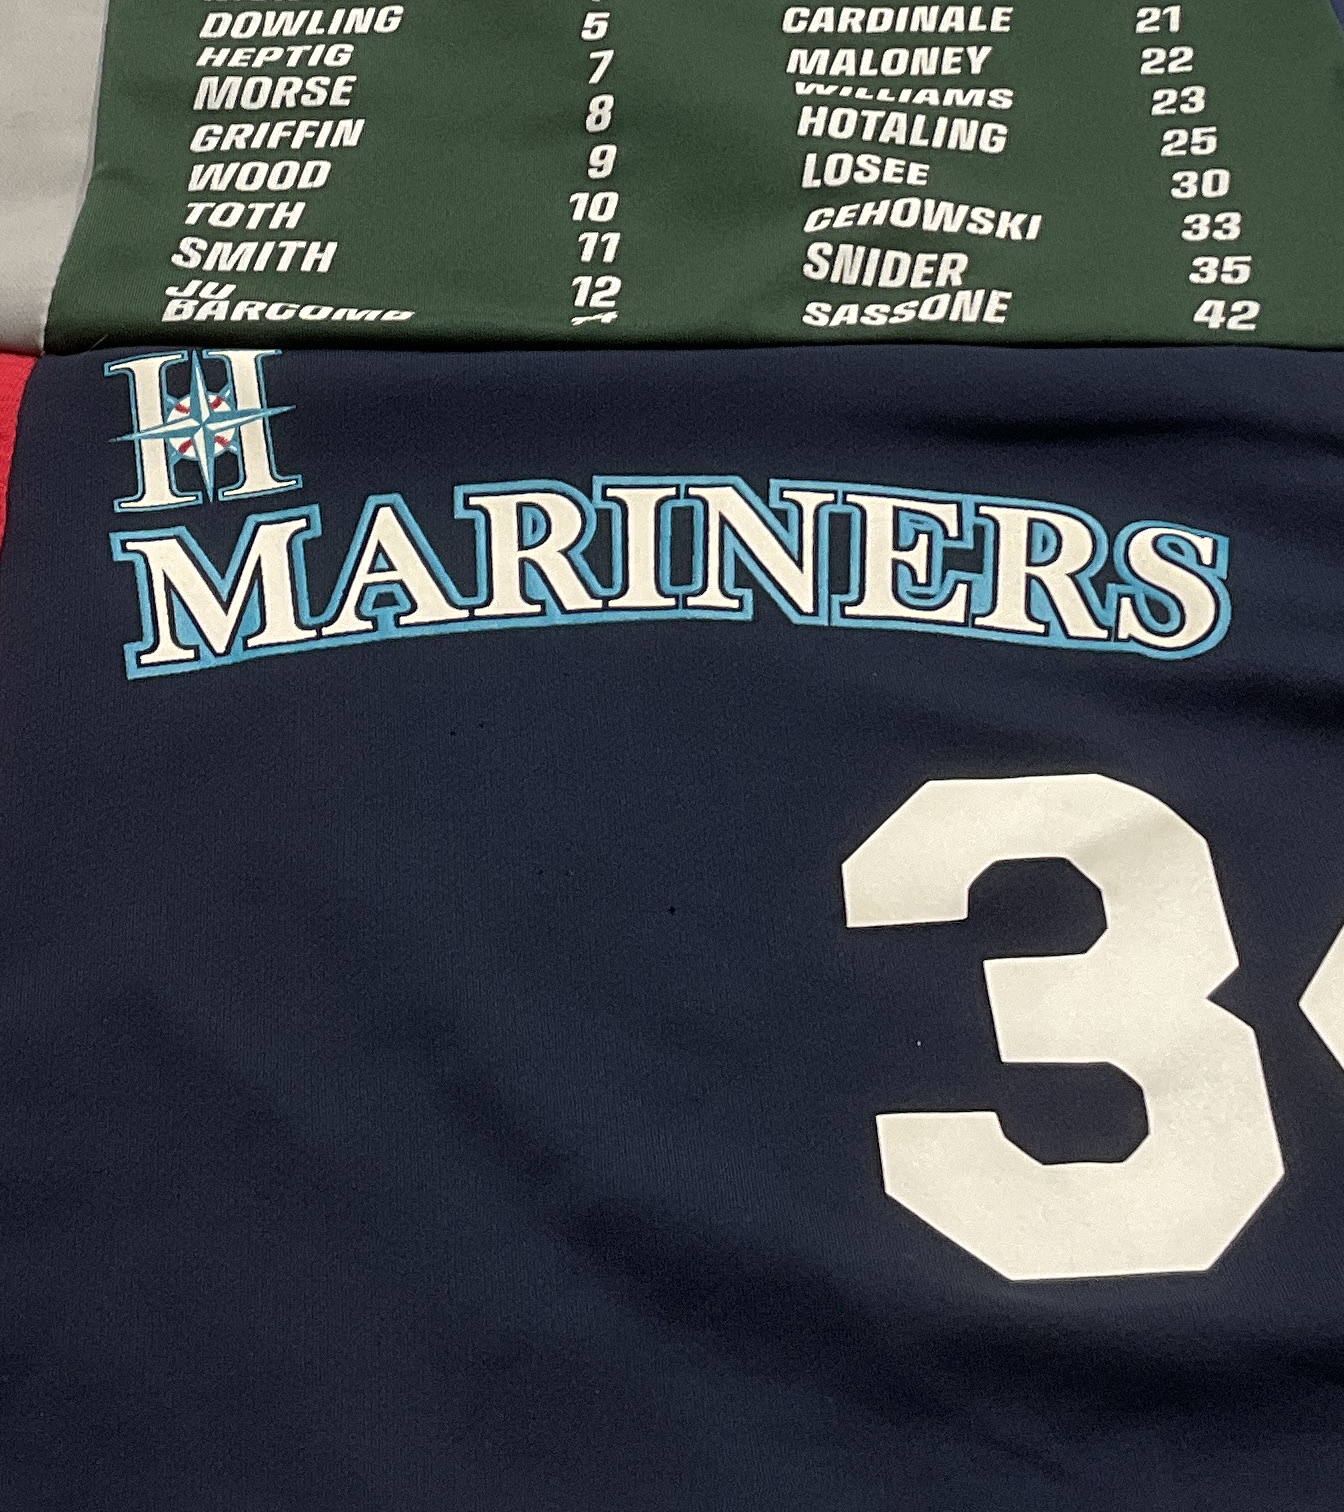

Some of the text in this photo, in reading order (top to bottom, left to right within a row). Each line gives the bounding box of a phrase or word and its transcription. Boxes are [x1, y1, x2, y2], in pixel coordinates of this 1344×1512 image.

[196, 12, 610, 67] HEPTIG 5
[199, 5, 404, 38] DOWLING
[782, 5, 1182, 33] CARDINALE 21
[192, 50, 614, 111] MORSE 7
[786, 46, 1195, 76] MALONEY 22
[189, 95, 614, 152] GRIFFIN 8
[1150, 85, 1207, 116] 23
[797, 105, 1218, 157] HOTALING 25
[187, 144, 618, 192] WOOD 9
[801, 152, 1231, 199] LOSEE 30
[185, 191, 619, 230] TOTH 10
[803, 196, 1243, 242] CEHOWSKI 33
[171, 232, 621, 273] SMITH 11
[802, 242, 1253, 288] SNIDER 35
[571, 275, 622, 307] 12
[802, 289, 1262, 331] SASSONE 42
[112, 474, 1232, 681] MARINERS
